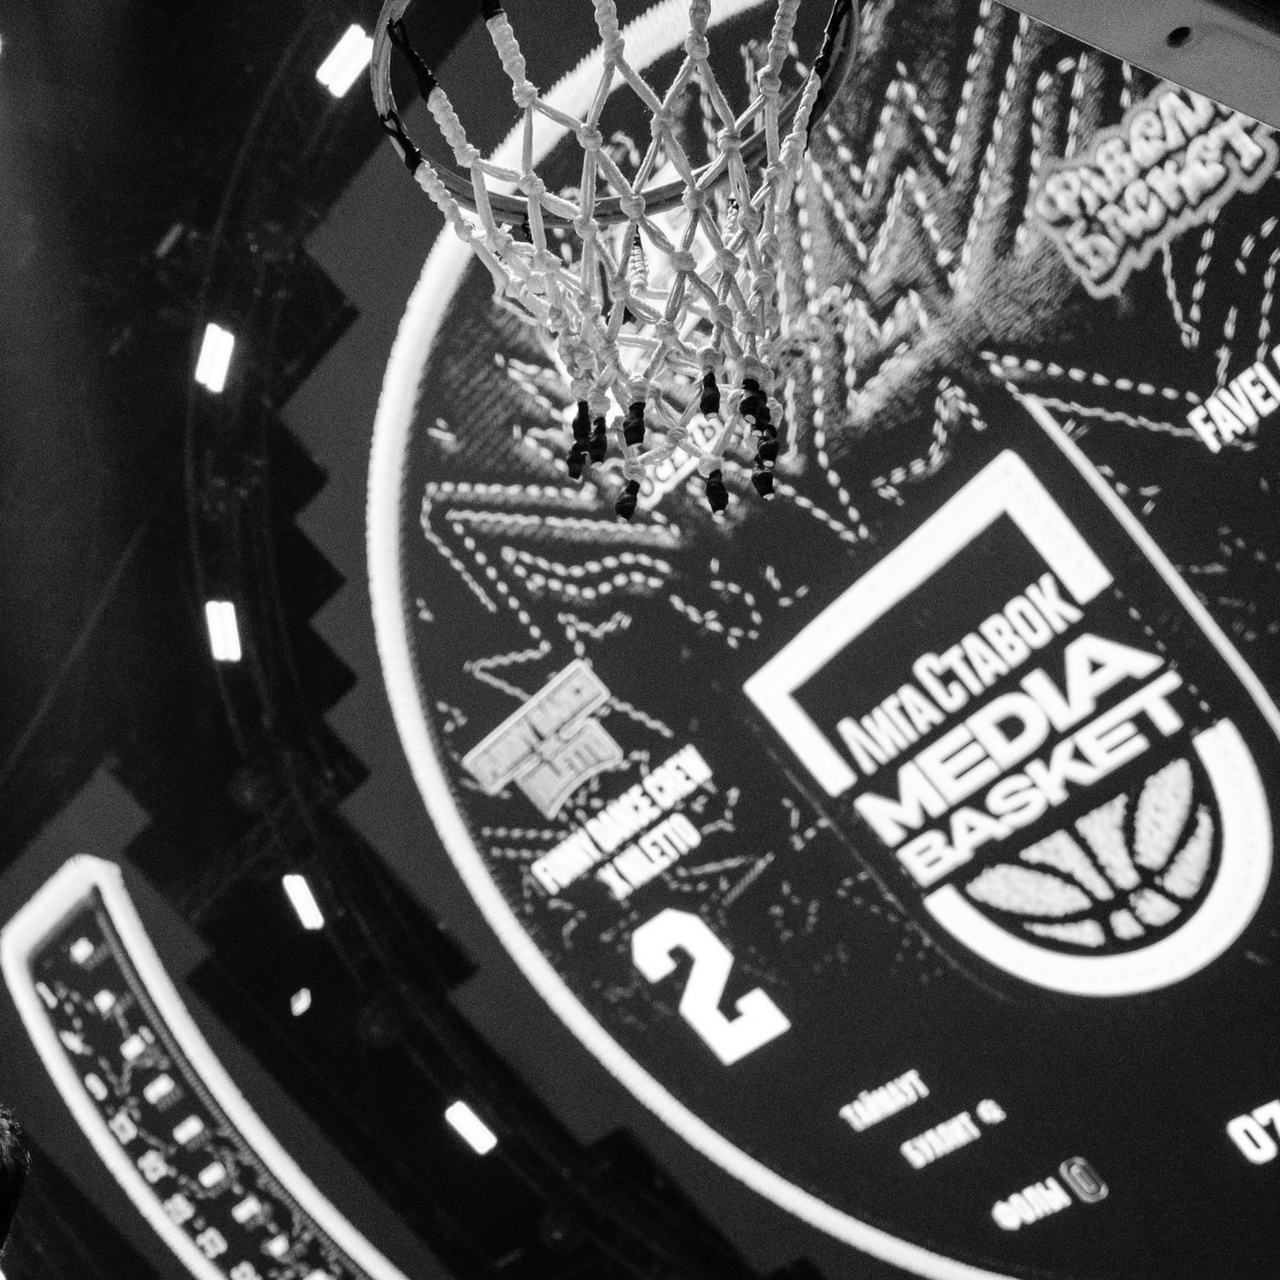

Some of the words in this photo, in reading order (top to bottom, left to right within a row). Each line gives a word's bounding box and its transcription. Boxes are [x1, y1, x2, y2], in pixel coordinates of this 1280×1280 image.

[1186, 343, 1280, 453] FAVEL
[837, 683, 945, 776] ЛИГА
[913, 572, 1084, 713] СТАВОК
[854, 633, 1165, 847] MEDIA
[896, 669, 1183, 887] BASKET
[631, 908, 792, 1066] 2
